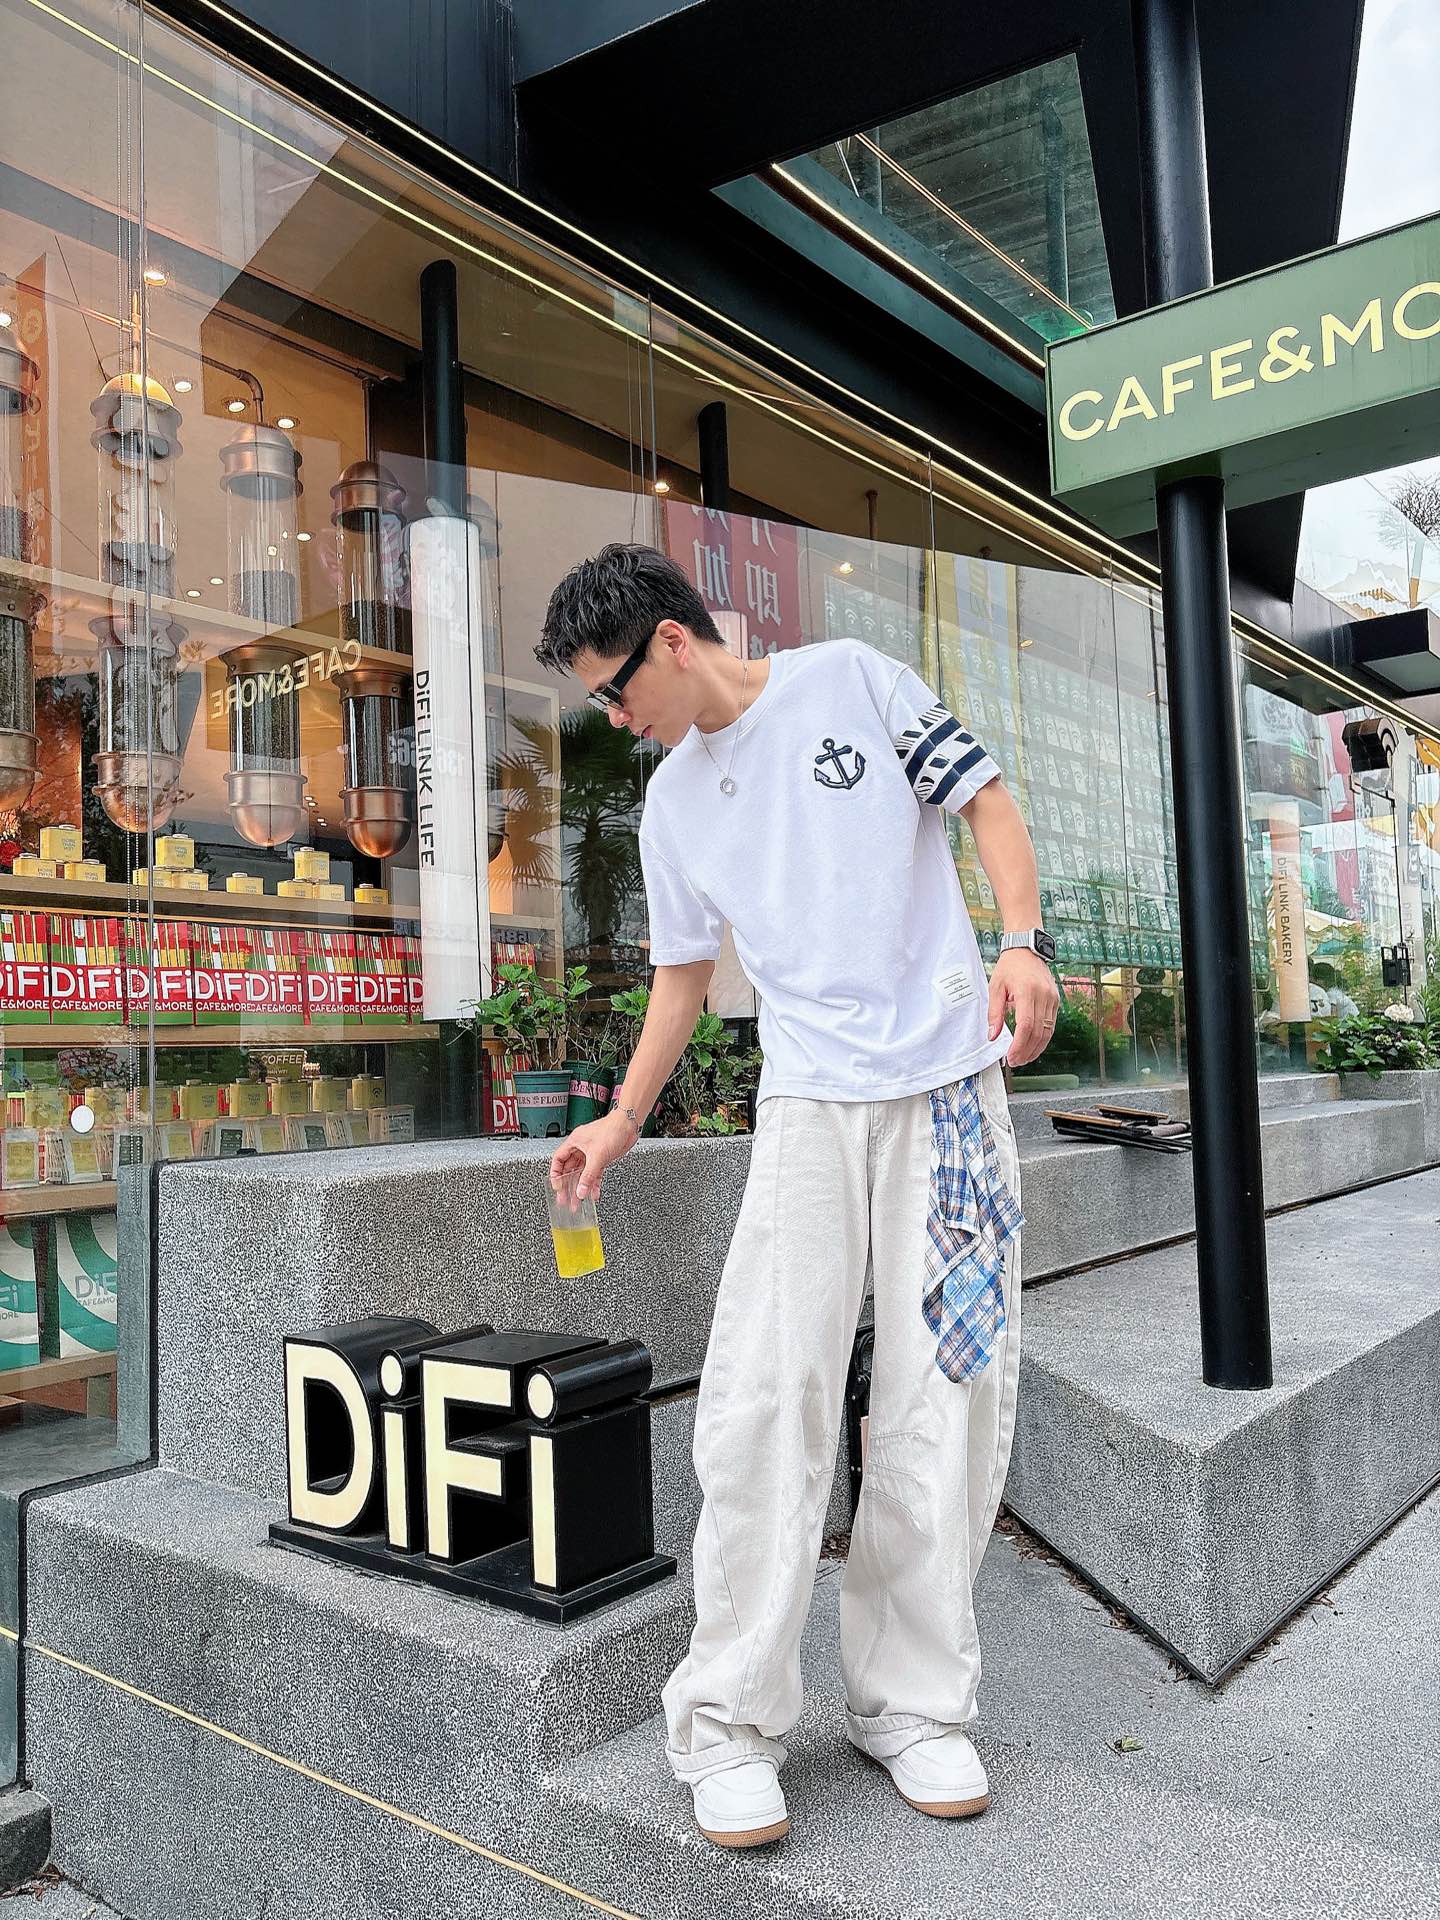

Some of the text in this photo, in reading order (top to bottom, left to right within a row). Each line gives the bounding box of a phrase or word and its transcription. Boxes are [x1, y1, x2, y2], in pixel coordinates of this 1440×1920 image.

[1058, 281, 1440, 441] CAFE&MO
[416, 670, 435, 868] DiFi LINK LIFE
[1278, 883, 1289, 913] LINK
[1280, 916, 1293, 967] BAKERY
[0, 964, 49, 997] iFi
[51, 966, 122, 999] DiFi
[195, 970, 250, 1001] DiFi
[250, 973, 302, 1003] DiFi
[308, 975, 359, 1003] DiFi
[360, 976, 408, 1003] DiFi
[52, 1000, 122, 1011] CAFE&MORE
[128, 1001, 192, 1011] CAF&MORE
[195, 1001, 251, 1012] CAFE&MORE
[309, 1003, 360, 1013] CAFE&MORE
[361, 1004, 408, 1013] CAFE&MORE
[261, 1054, 303, 1065] COFFEE
[285, 1342, 557, 1588] DiFi
